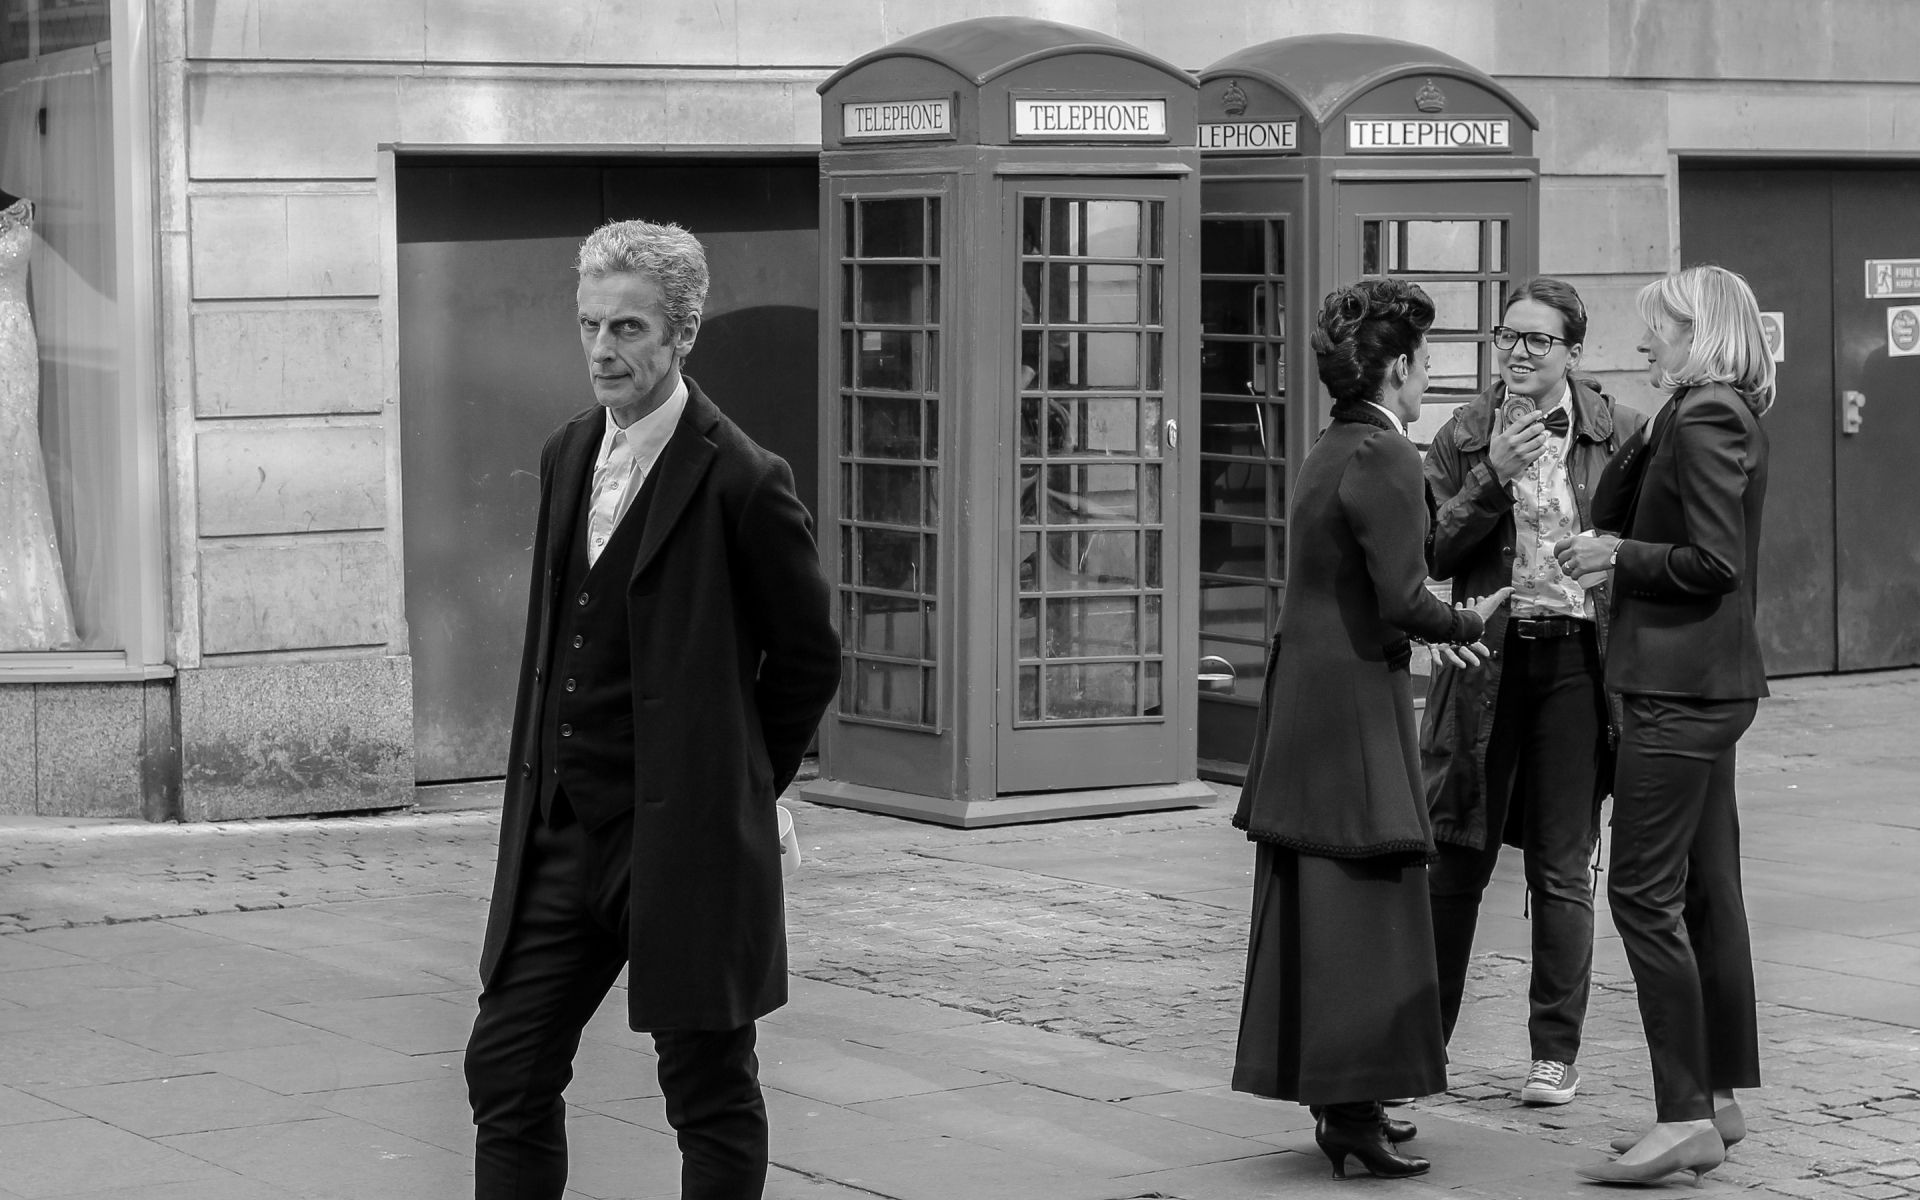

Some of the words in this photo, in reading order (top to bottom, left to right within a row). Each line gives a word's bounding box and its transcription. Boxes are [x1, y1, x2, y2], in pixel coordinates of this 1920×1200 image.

[855, 104, 943, 132] TELEPHONE
[1030, 104, 1150, 131] TELEPHONE
[1199, 124, 1294, 148] LEPHONE
[1354, 122, 1504, 146] TELEPHONE
